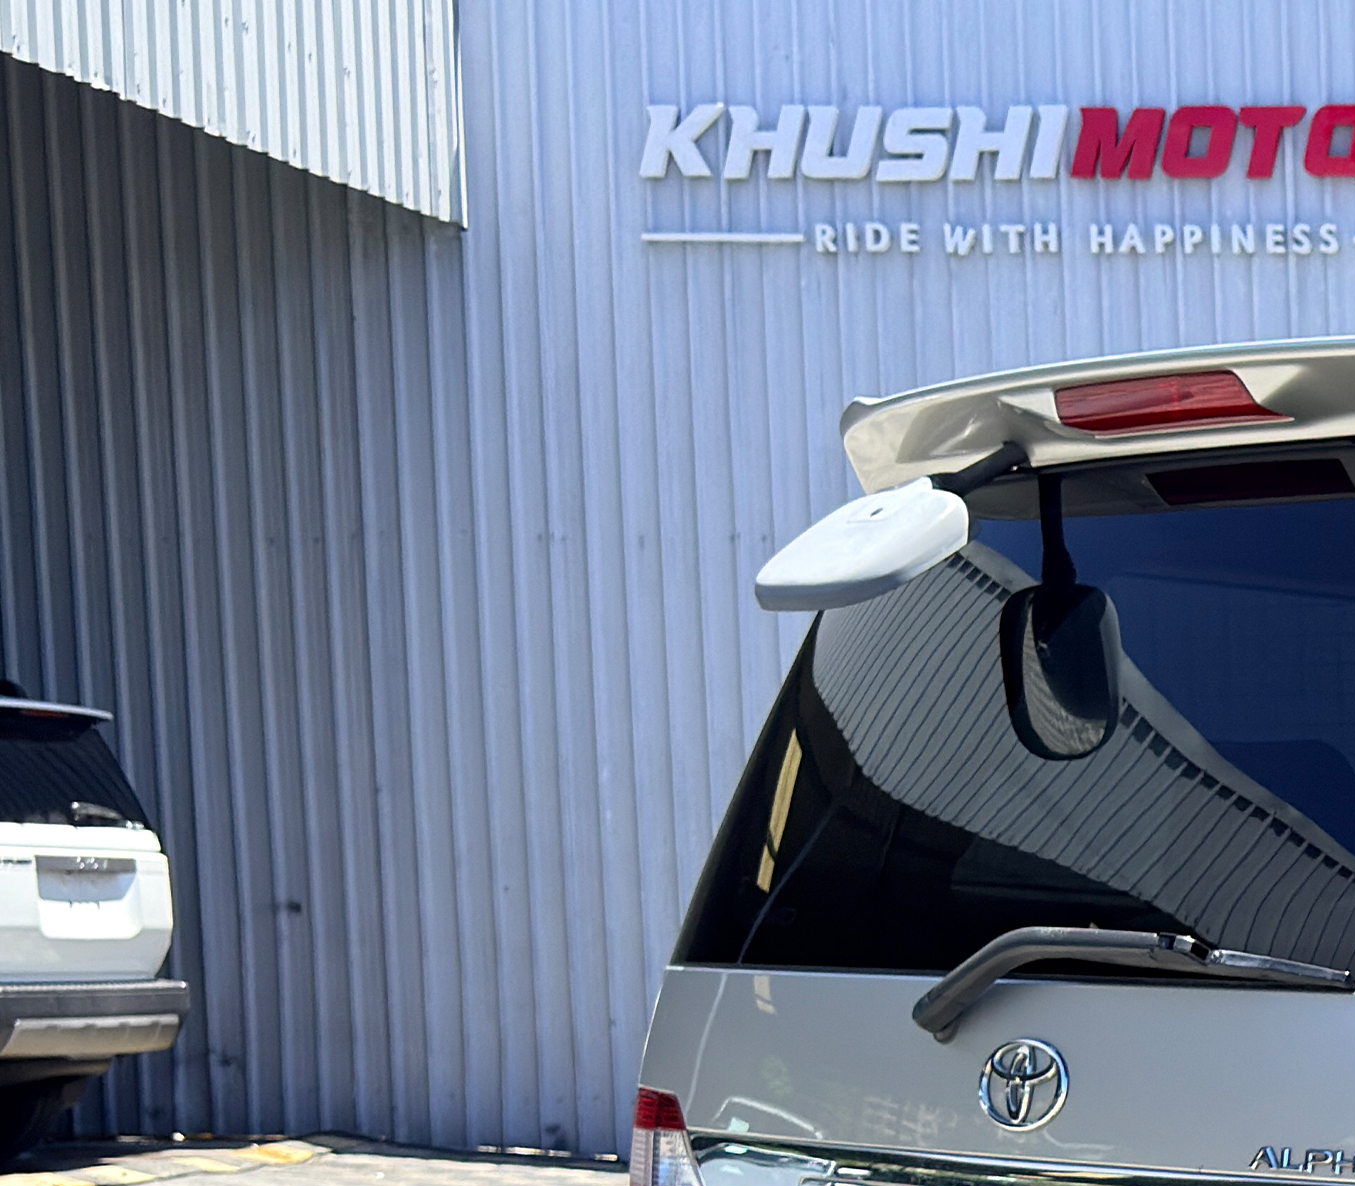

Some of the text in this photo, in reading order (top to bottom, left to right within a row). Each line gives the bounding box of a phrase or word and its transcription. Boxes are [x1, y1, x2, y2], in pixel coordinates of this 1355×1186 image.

[814, 223, 1342, 256] RIDE WITH HAPPINESS
